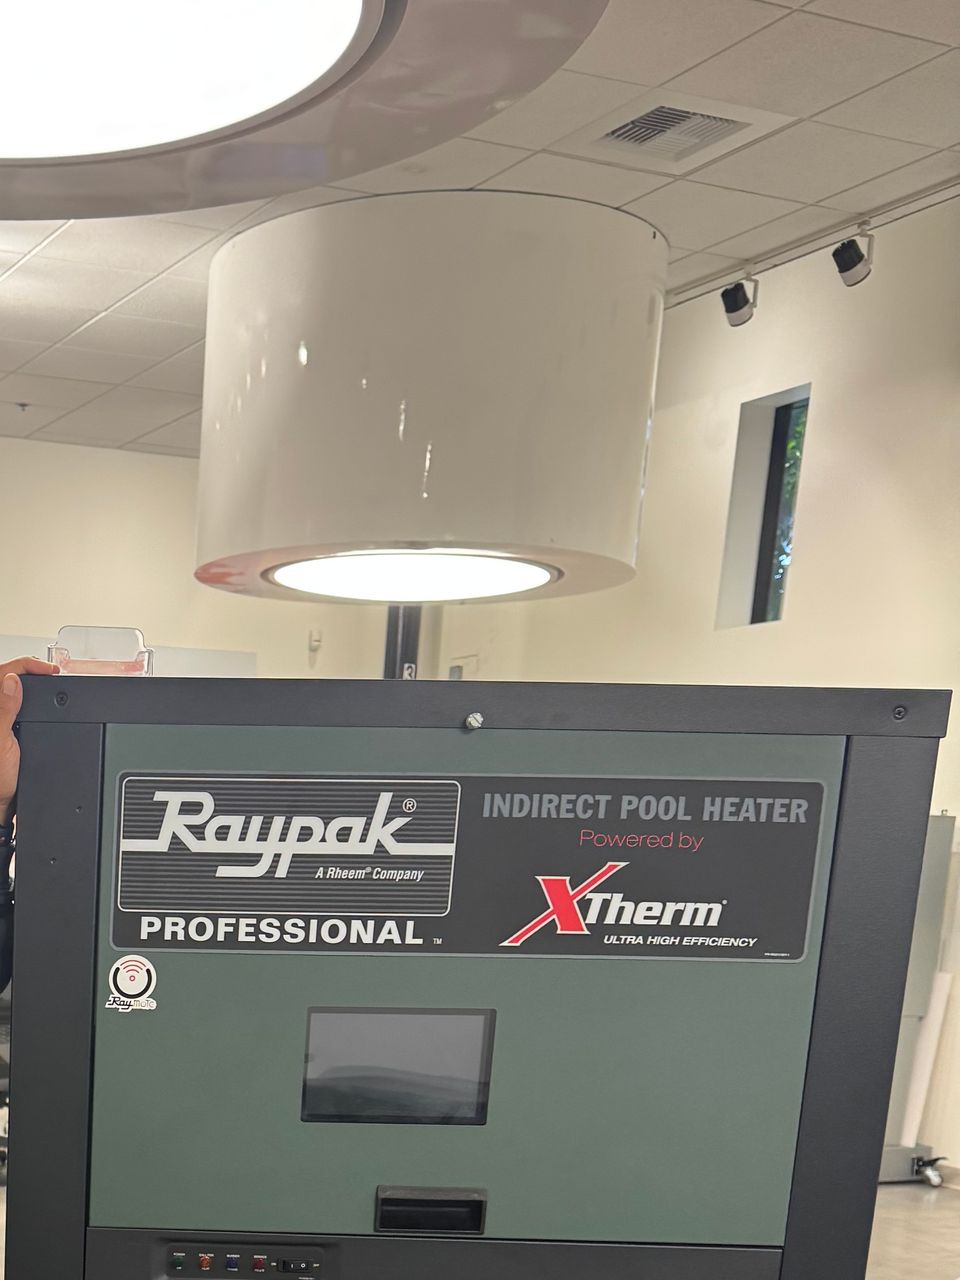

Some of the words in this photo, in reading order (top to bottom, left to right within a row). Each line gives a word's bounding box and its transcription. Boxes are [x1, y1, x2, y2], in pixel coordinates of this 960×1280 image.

[482, 793, 611, 819] INDIRECT
[620, 796, 692, 821] POOL
[702, 797, 808, 823] HEATER
[579, 829, 674, 848] Powered
[678, 831, 705, 852] by
[315, 866, 324, 879] A
[372, 867, 425, 882] Company
[140, 916, 424, 945] PROFESSIONAL
[603, 935, 644, 944] ULTRA
[646, 936, 680, 945] HIGH
[682, 936, 758, 947] EFFICIENCY
